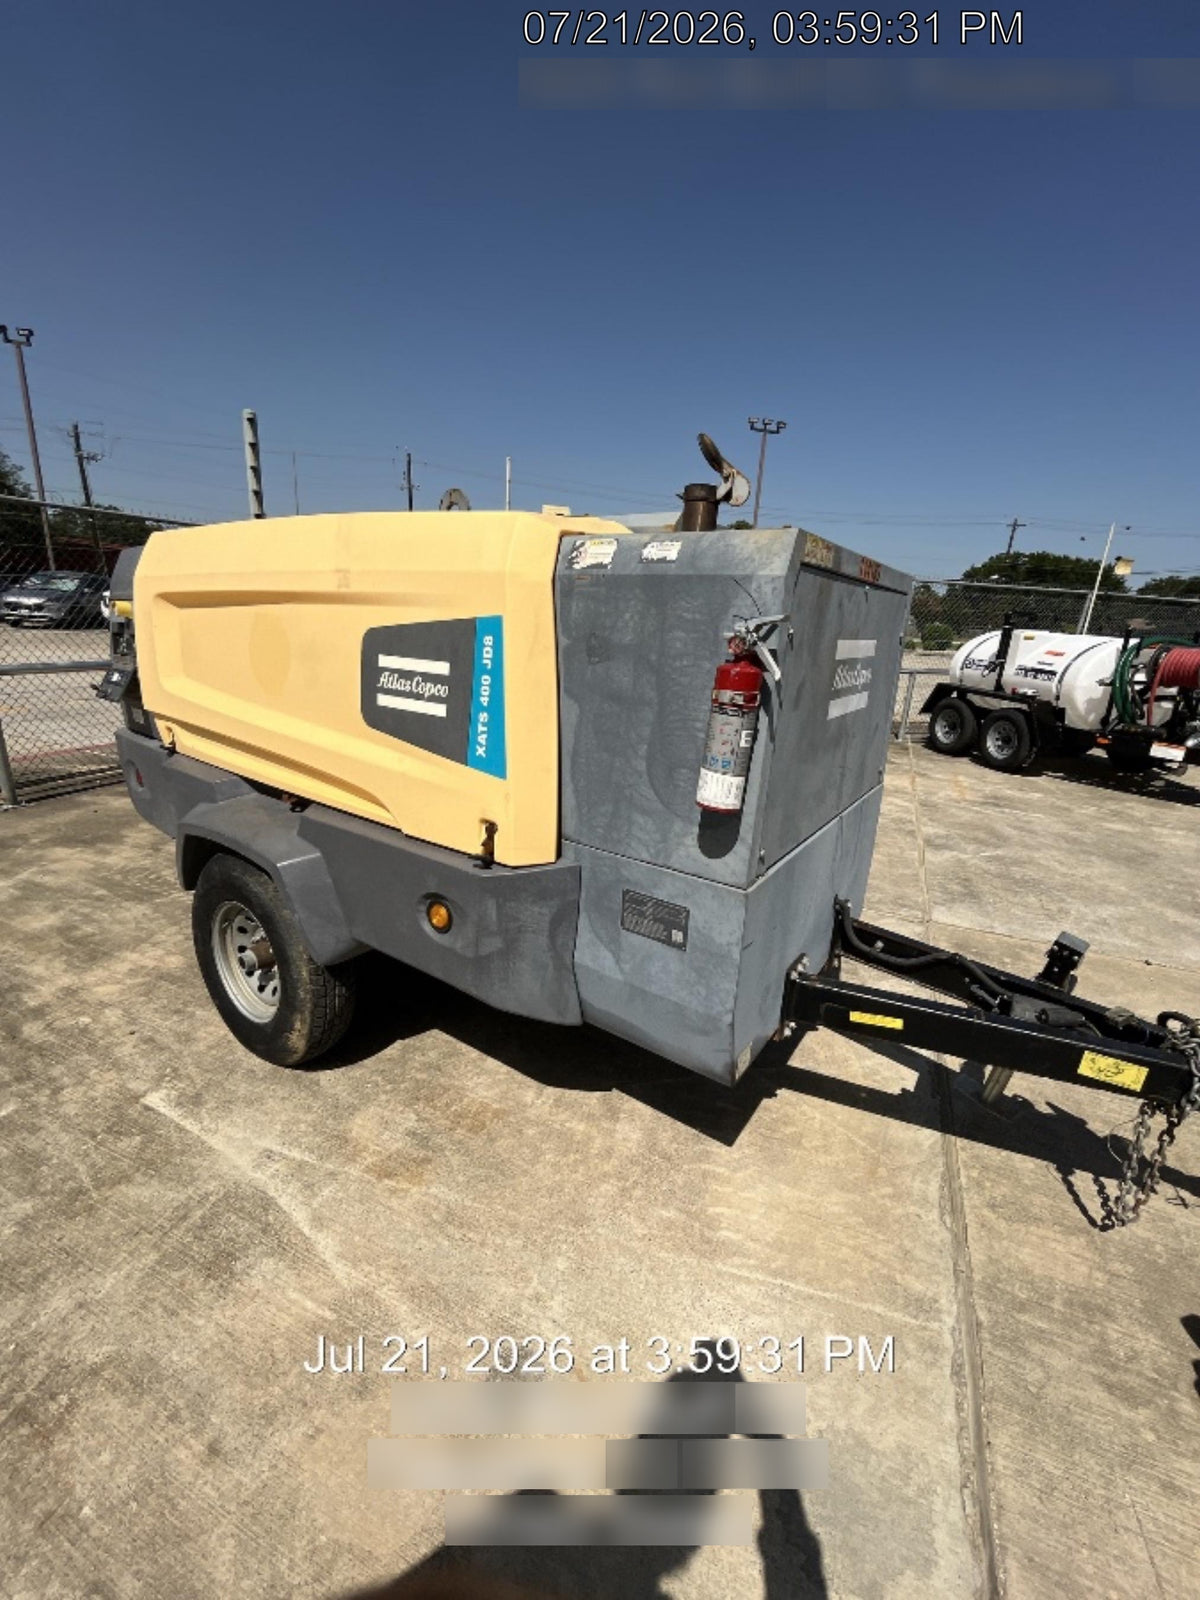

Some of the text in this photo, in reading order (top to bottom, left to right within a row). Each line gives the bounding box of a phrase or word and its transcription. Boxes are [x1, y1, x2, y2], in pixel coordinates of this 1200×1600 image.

[476, 635, 493, 758] XATS 400 JD8
